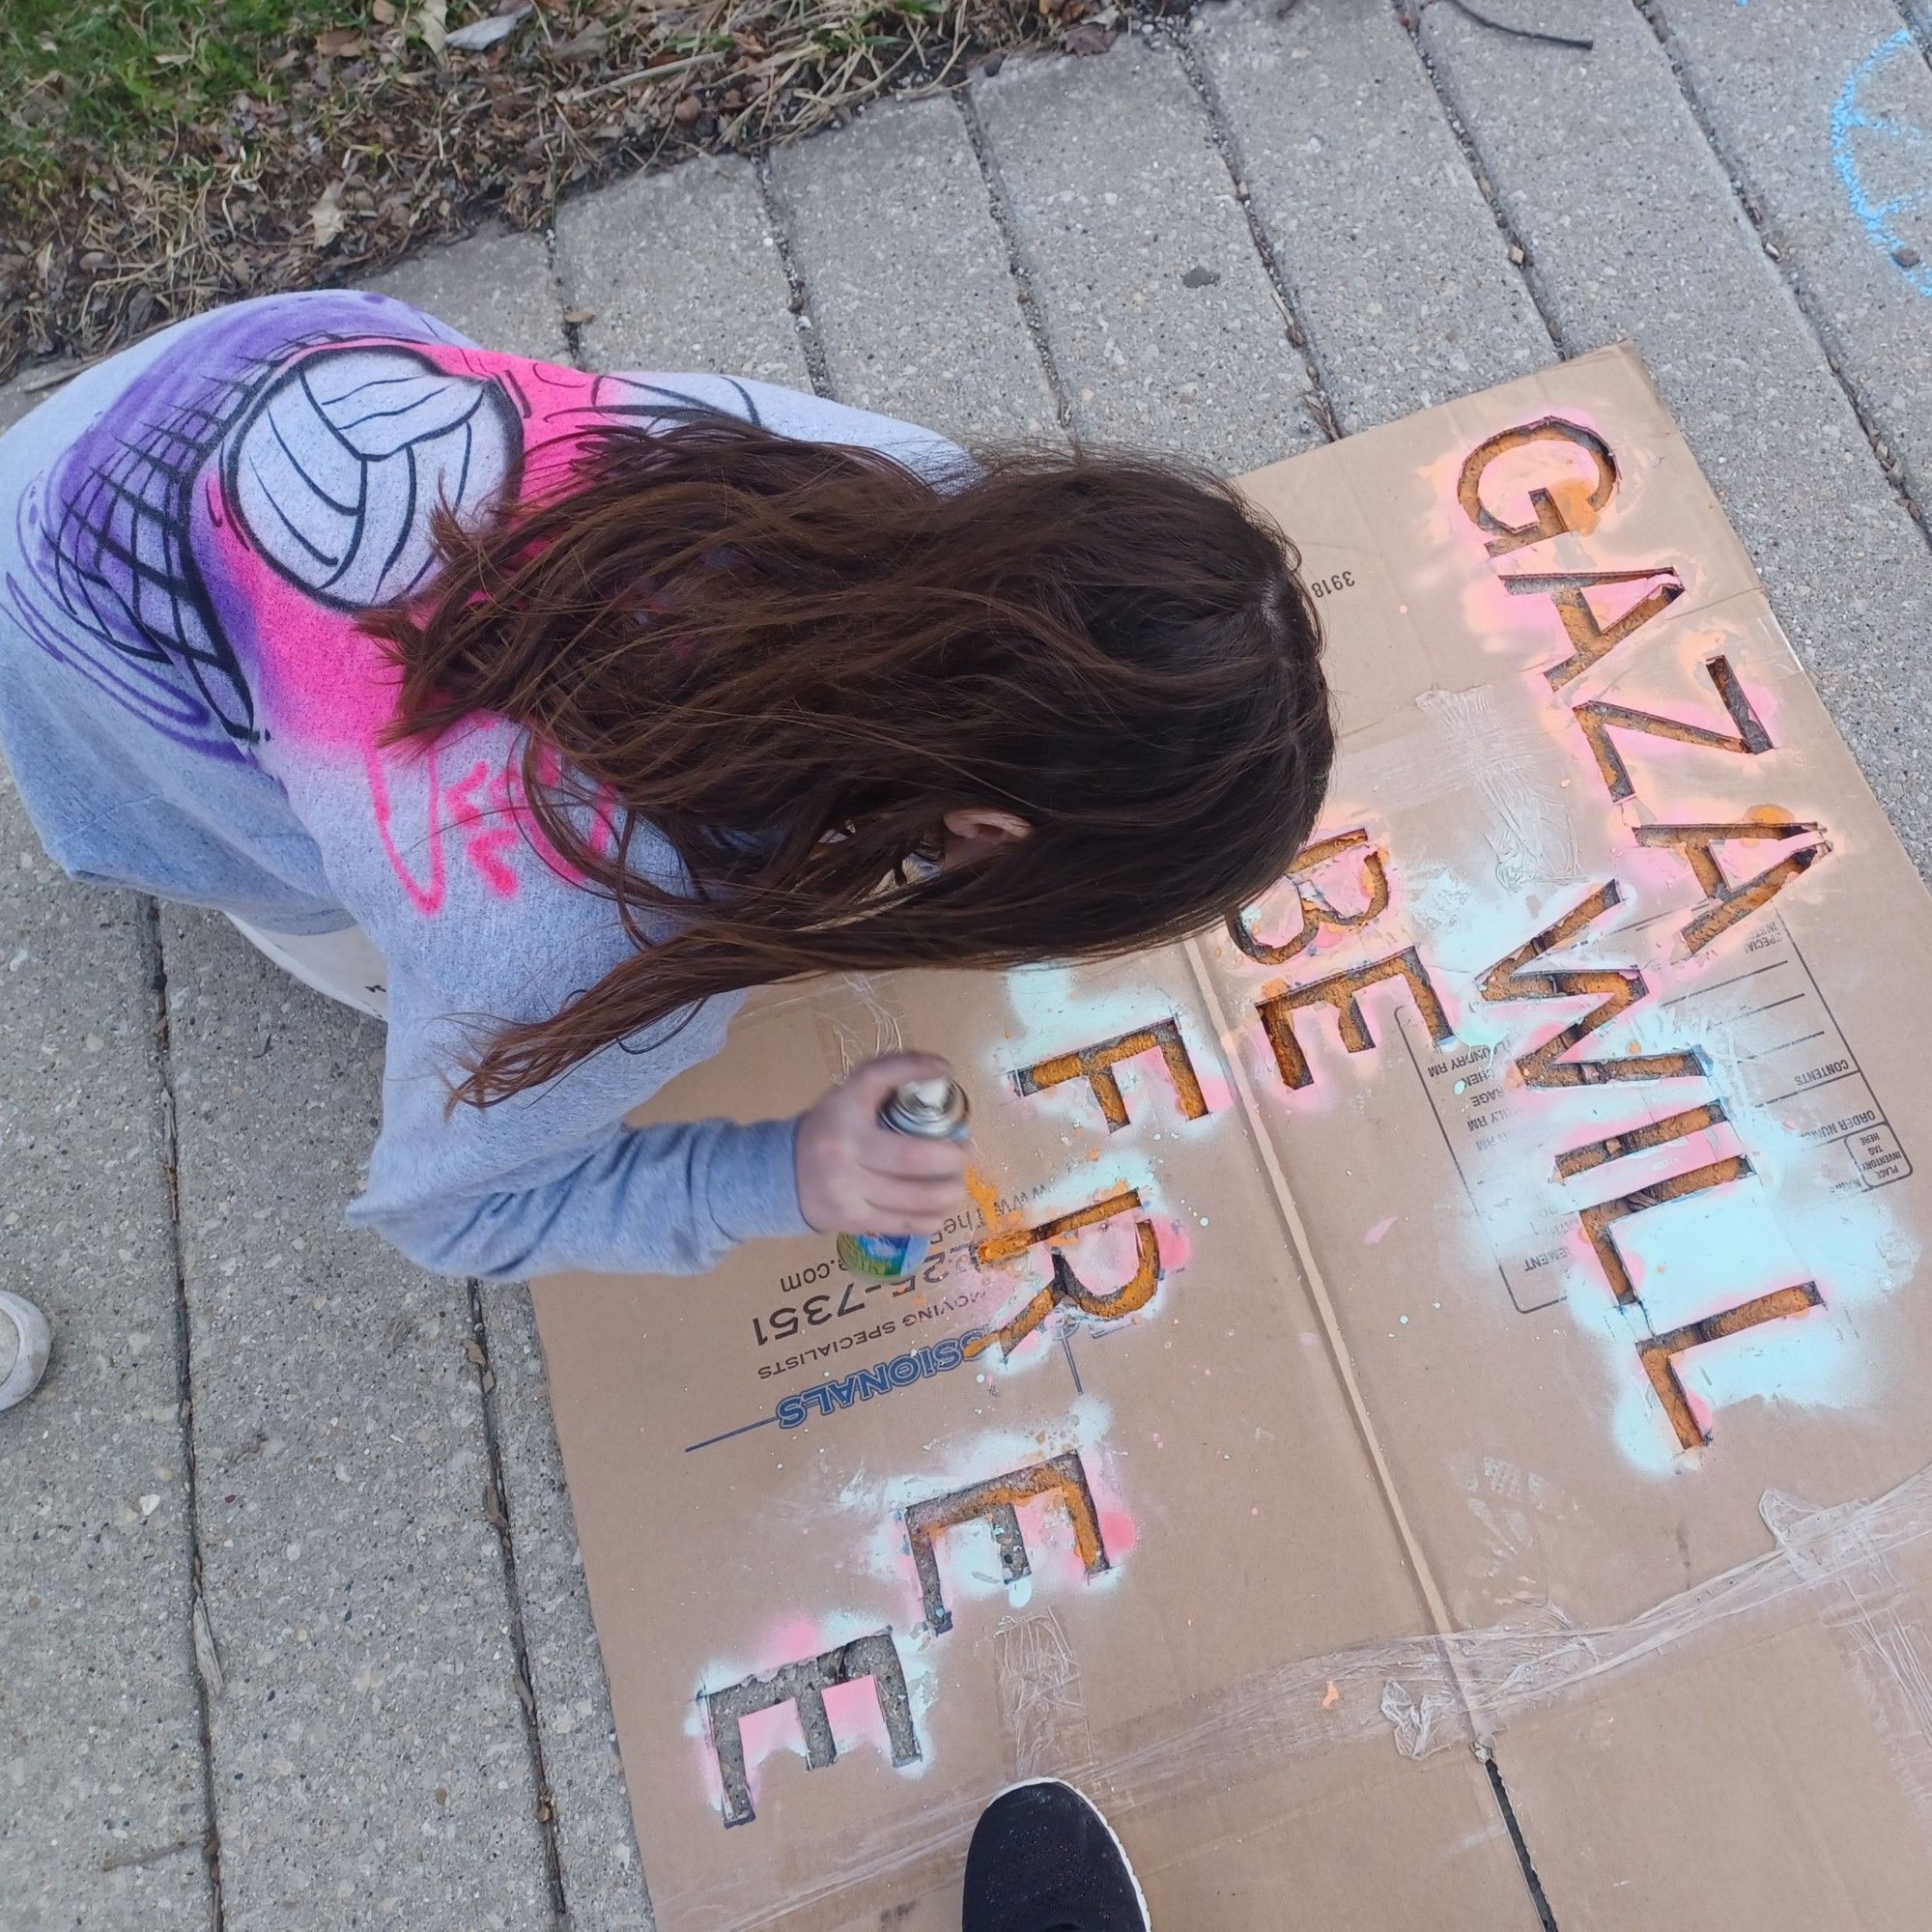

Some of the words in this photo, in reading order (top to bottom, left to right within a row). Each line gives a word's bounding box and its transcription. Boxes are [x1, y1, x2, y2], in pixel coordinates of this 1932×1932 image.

[1311, 570, 1354, 598] 3918
[1457, 415, 1833, 954] GAZA
[1227, 827, 1457, 1093] BE
[1428, 1061, 1449, 1077] RM
[1794, 1059, 1849, 1086] CONTENTS
[1466, 1116, 1488, 1132] RM
[1838, 1110, 1876, 1131] ORDER
[1859, 1132, 1880, 1146] HERE
[1867, 1145, 1883, 1155] TAG
[1476, 878, 1826, 1451] WILL
[1862, 1151, 1902, 1170] INVENTORY
[1876, 1165, 1899, 1179] PLACE
[902, 1291, 985, 1326] MOVING
[757, 1321, 896, 1379] SPECIALISTS
[700, 1016, 1214, 1830] FREE
